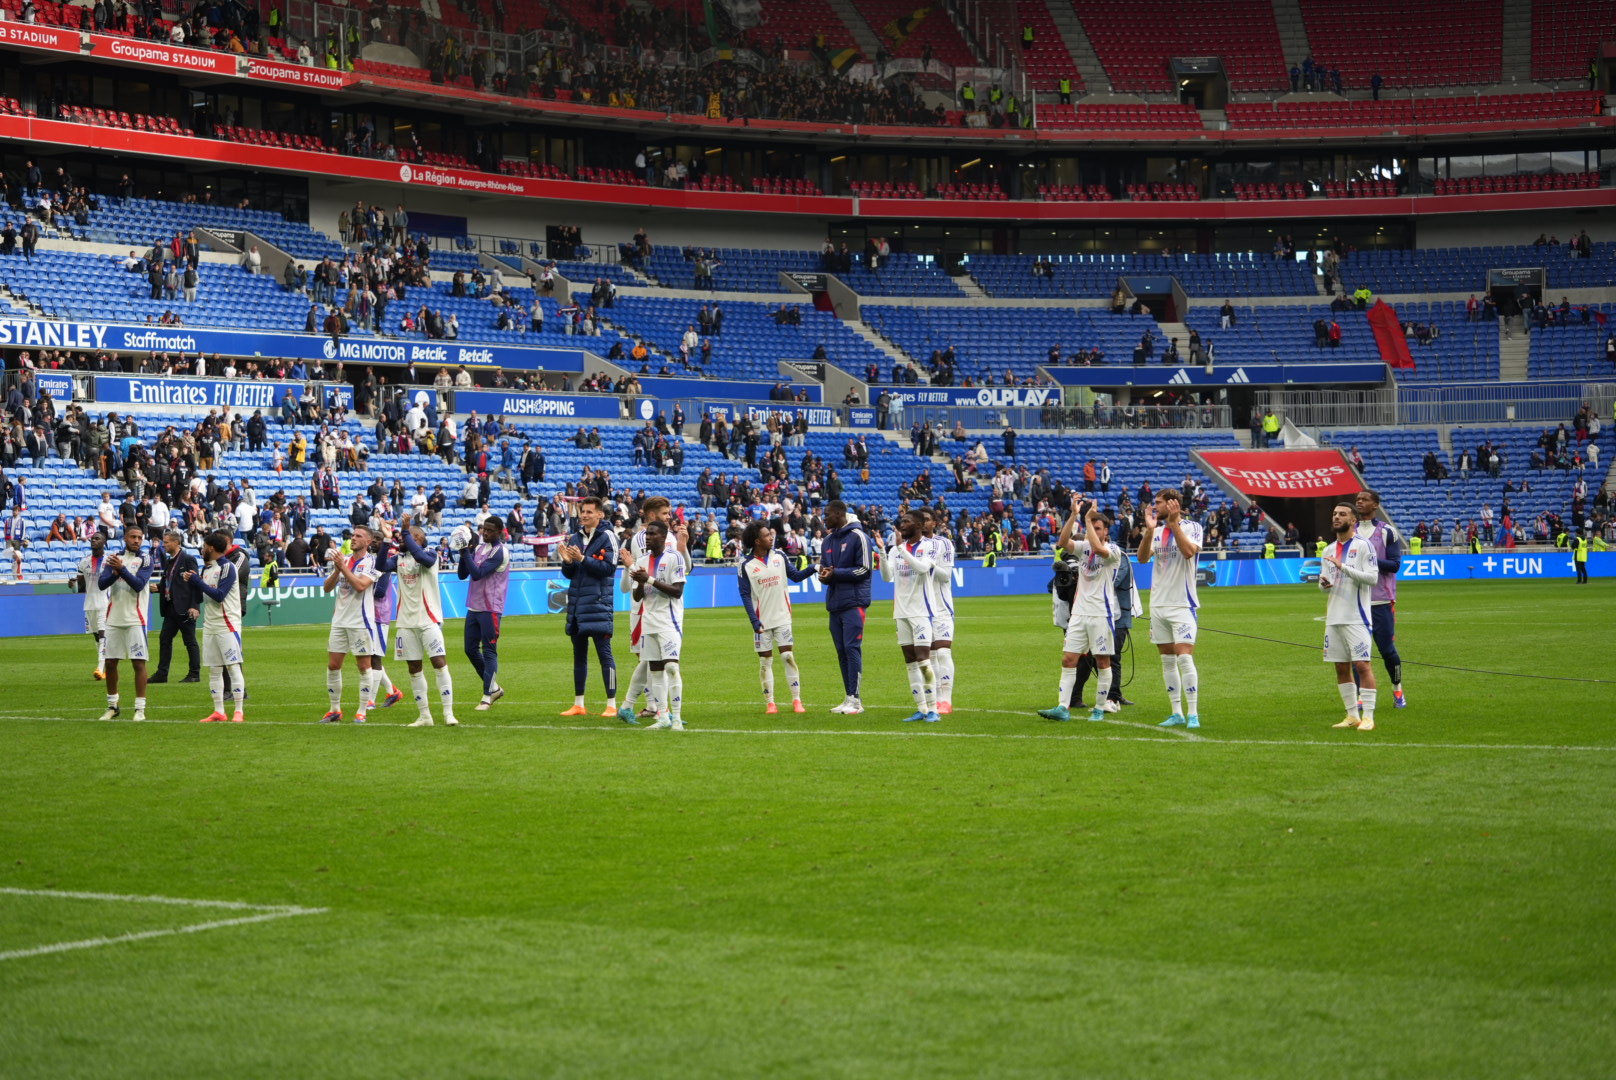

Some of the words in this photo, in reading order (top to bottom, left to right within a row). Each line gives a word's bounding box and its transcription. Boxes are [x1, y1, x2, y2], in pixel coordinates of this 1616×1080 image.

[10, 29, 58, 46] STADIUM
[111, 41, 169, 62] Groupama
[172, 53, 216, 69] STADIUM
[248, 61, 300, 80] Groupama
[303, 72, 343, 86] STADIUM
[413, 169, 424, 181] La
[425, 170, 456, 185] Région
[458, 178, 524, 192] Auvergne-Rhône-Alpes
[0, 320, 107, 348] STANLEY
[123, 331, 196, 350] Staffmatch
[340, 343, 360, 358] MG
[362, 344, 406, 360] MOTOR
[412, 346, 448, 361] Betclic
[458, 348, 494, 363] Betclic
[38, 378, 69, 389] Emirates
[129, 380, 208, 404] Emirates
[214, 384, 234, 406] FLY
[235, 384, 274, 407] BETTER
[918, 392, 928, 402] FLY
[928, 392, 948, 402] BETTER
[808, 408, 831, 425] BETTER
[1218, 465, 1346, 481] Emirates
[1247, 478, 1271, 489] FLY
[1277, 476, 1334, 490] BETTER
[1403, 559, 1445, 576] ZEN
[1502, 558, 1543, 575] FUN
